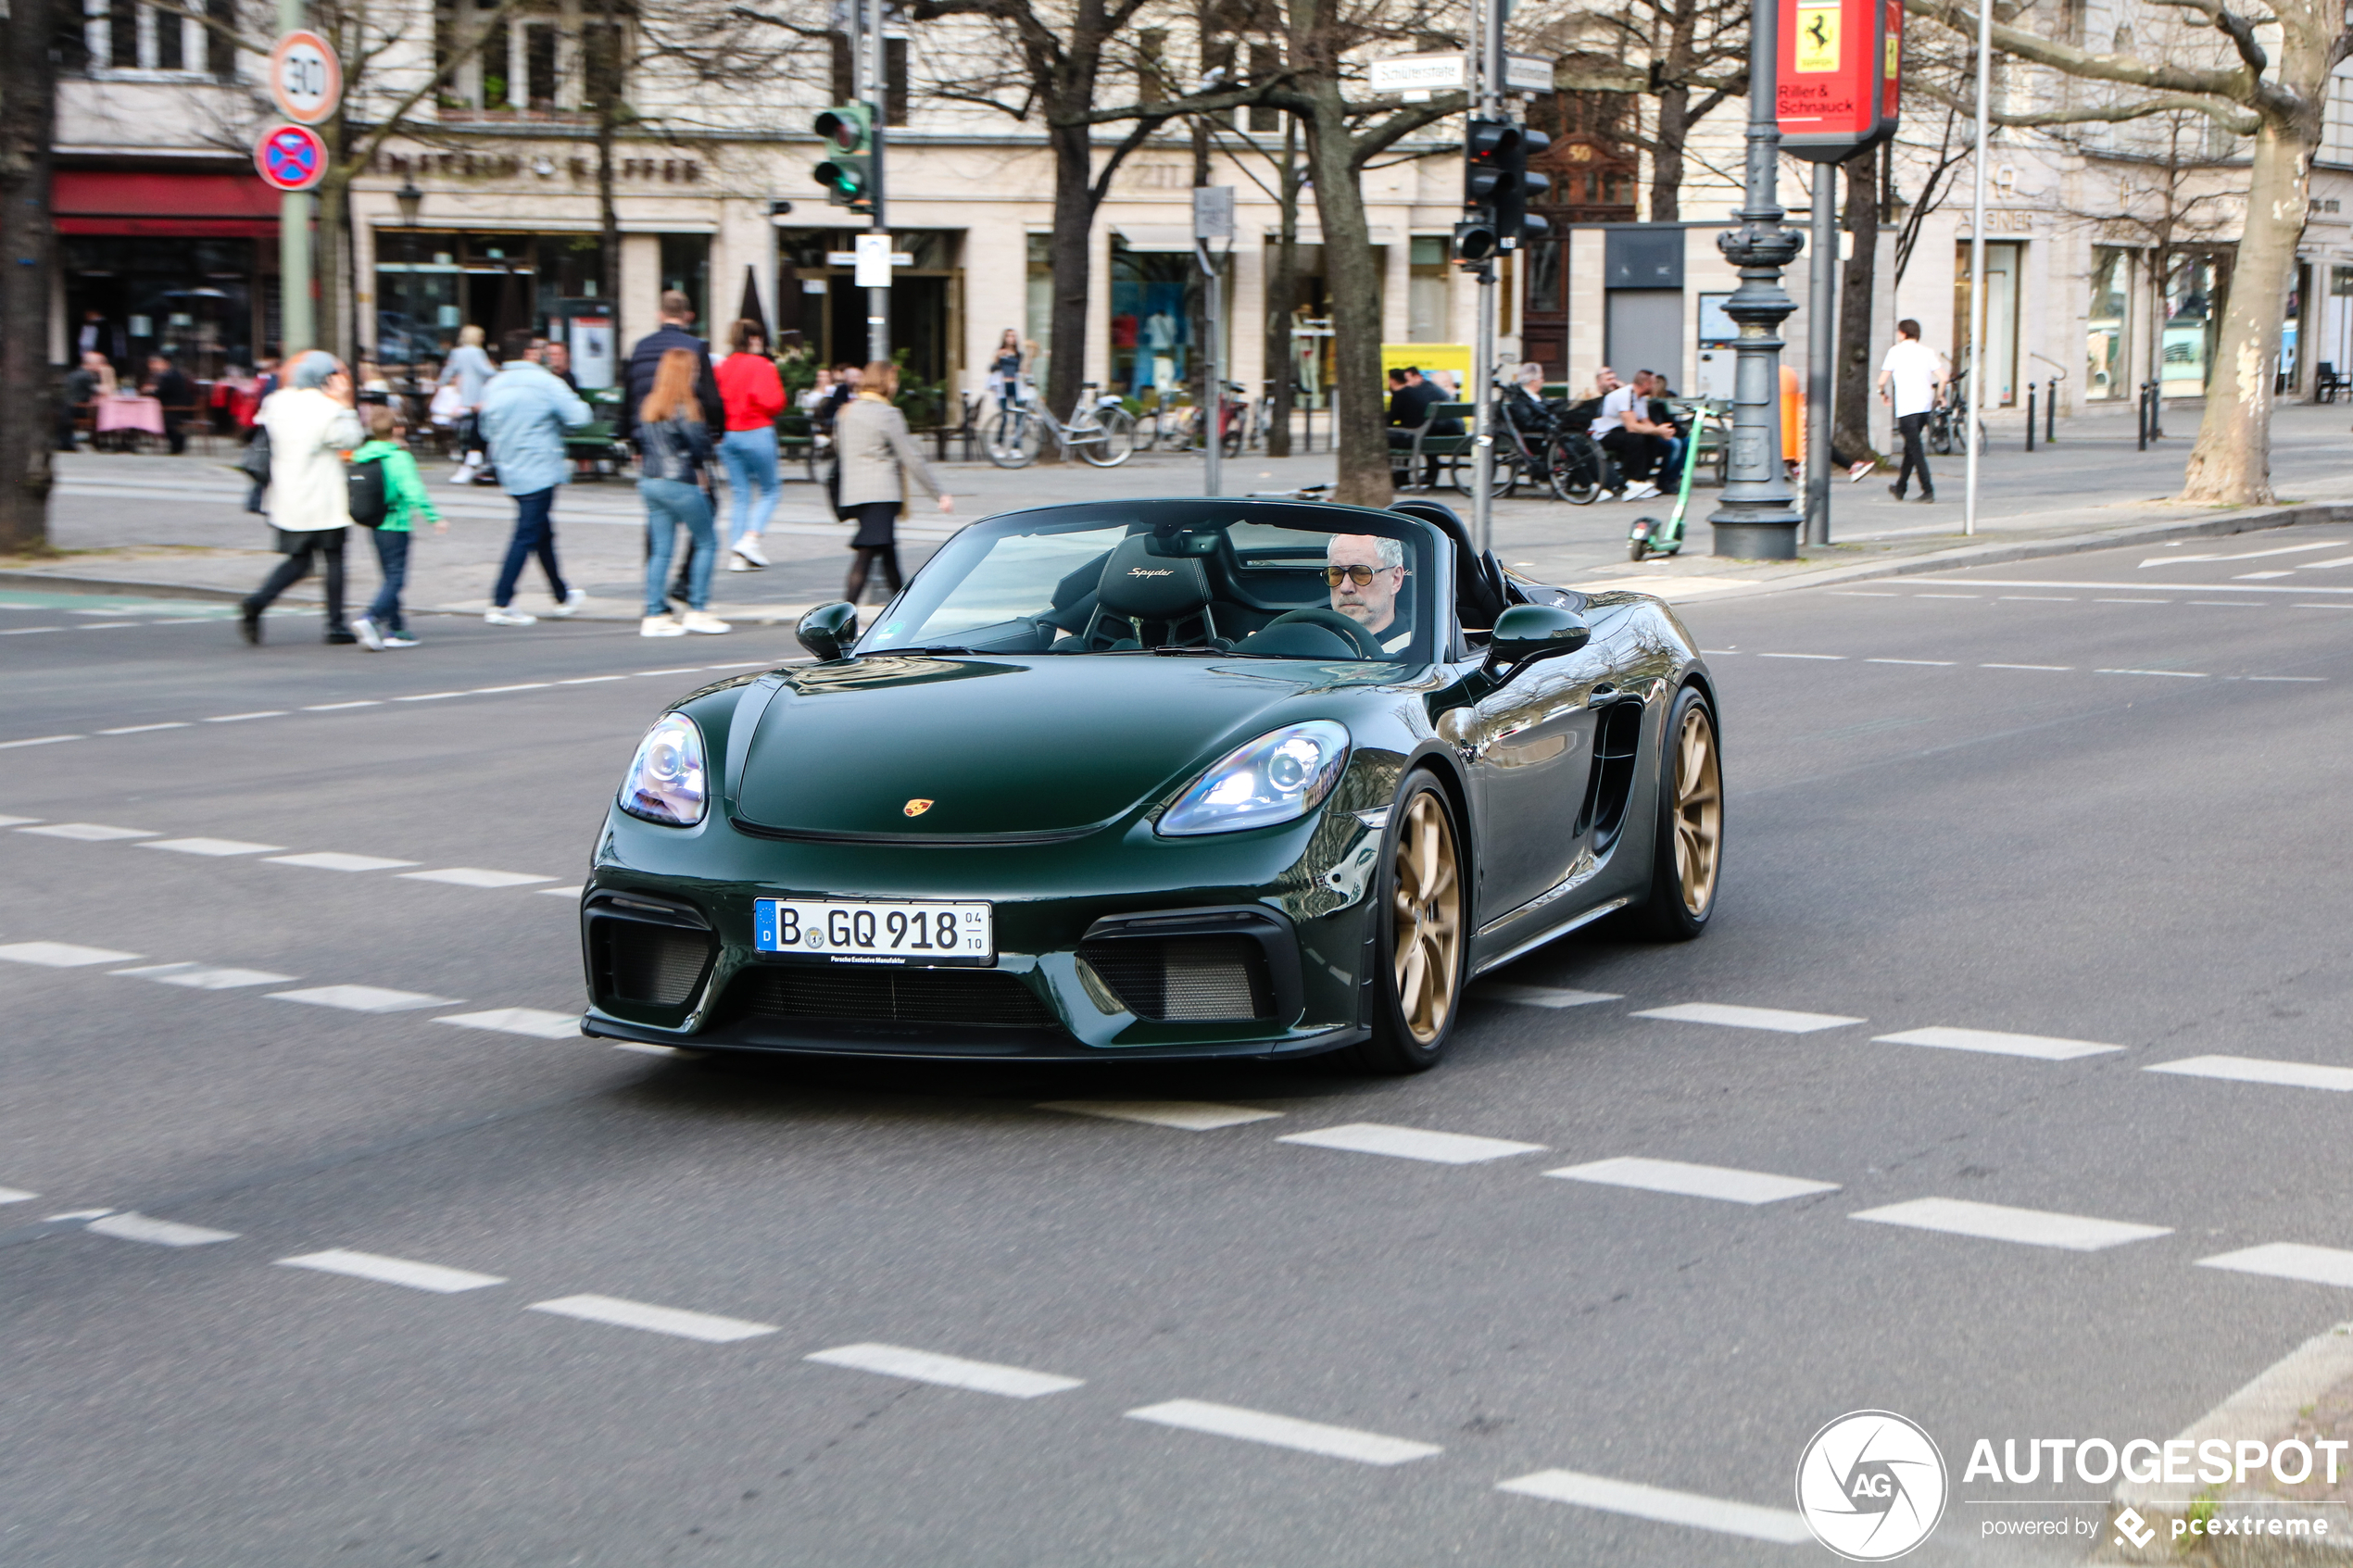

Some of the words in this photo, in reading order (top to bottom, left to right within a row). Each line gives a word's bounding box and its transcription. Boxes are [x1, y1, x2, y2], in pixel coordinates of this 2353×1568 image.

[281, 56, 327, 96] 30
[1818, 83, 1829, 97] &
[1778, 98, 1854, 114] Schnauck
[1956, 211, 2032, 231] AGNER
[1126, 567, 1175, 580] Spyder
[965, 912, 982, 923] 04
[780, 908, 801, 946] B
[827, 909, 875, 948] GQ
[886, 910, 958, 950] 918
[762, 930, 772, 942] D
[966, 937, 982, 949] 10
[851, 956, 875, 964] Exclusive
